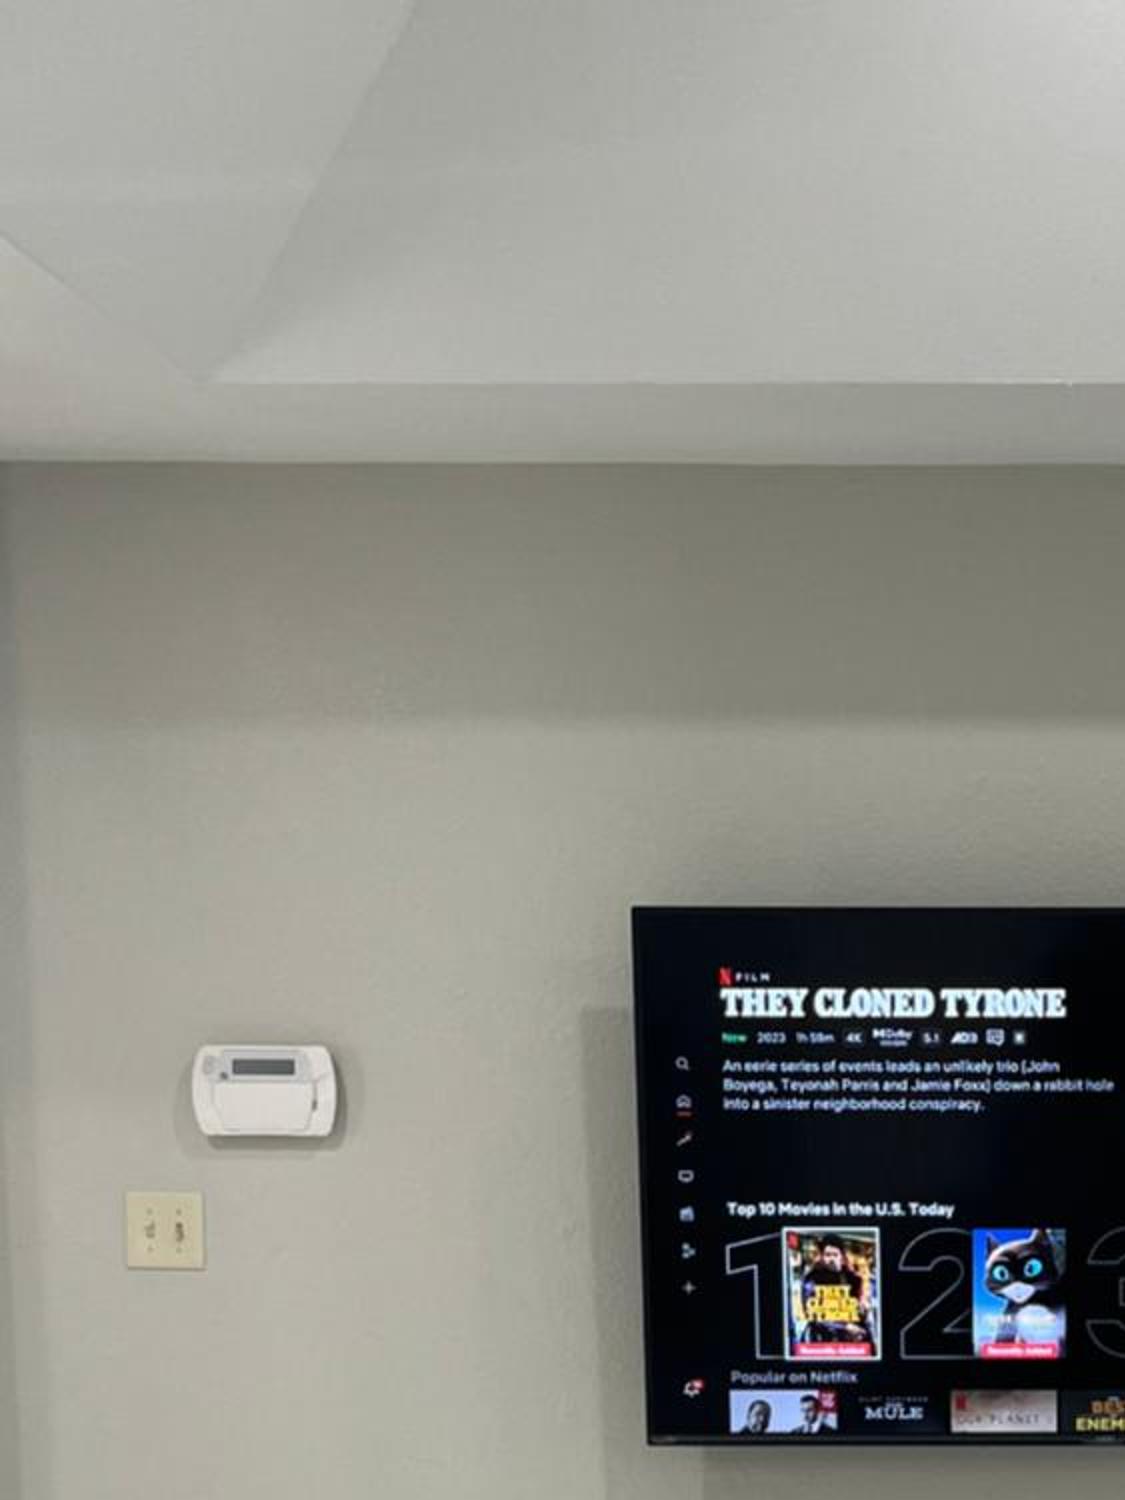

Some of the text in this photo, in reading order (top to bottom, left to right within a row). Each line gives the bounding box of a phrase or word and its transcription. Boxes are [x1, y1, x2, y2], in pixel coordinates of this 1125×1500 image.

[735, 972, 771, 982] FILM
[719, 987, 1067, 1018] THEY CLONED TYRONE
[757, 1031, 787, 1044] 2023
[722, 1059, 1061, 1075] An eerie series of events leads an unlikely trio (John
[722, 1078, 1115, 1094] Boyega, Teyonah Parris and Jamie Foxx) down a rabbit hole
[751, 1100, 760, 1110] a
[763, 1098, 810, 1110] sinister
[813, 1098, 906, 1113] neighborhood
[908, 1098, 985, 1113] conspiracy.
[726, 1202, 955, 1219] Top 10 Movies in the U.S. Today
[730, 1370, 859, 1385] Popular on Netflix
[864, 1406, 925, 1420] MULE
